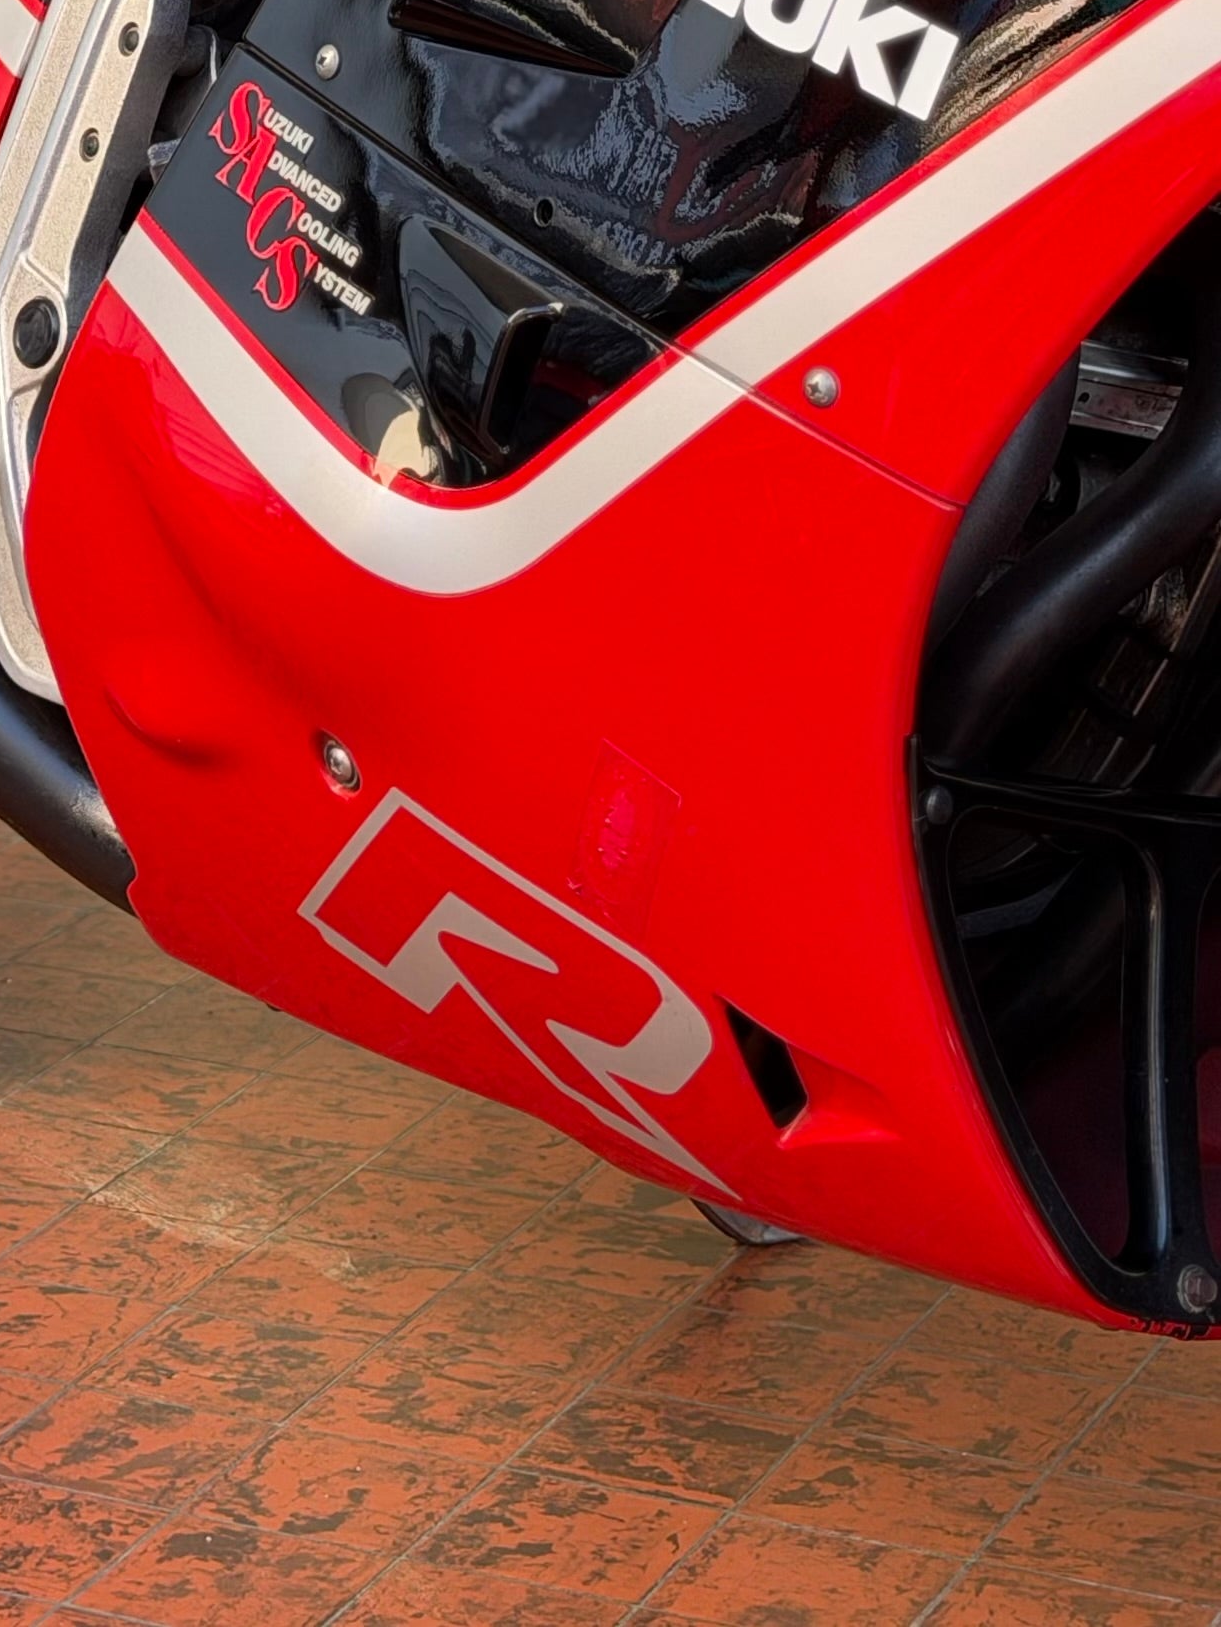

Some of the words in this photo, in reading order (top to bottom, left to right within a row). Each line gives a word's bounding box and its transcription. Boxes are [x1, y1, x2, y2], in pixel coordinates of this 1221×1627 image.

[208, 80, 314, 156] SUZUKI
[214, 126, 343, 213] ADVANCED
[246, 186, 360, 268] COOLING
[253, 236, 372, 316] SYSTEM
[298, 786, 741, 1202] R
